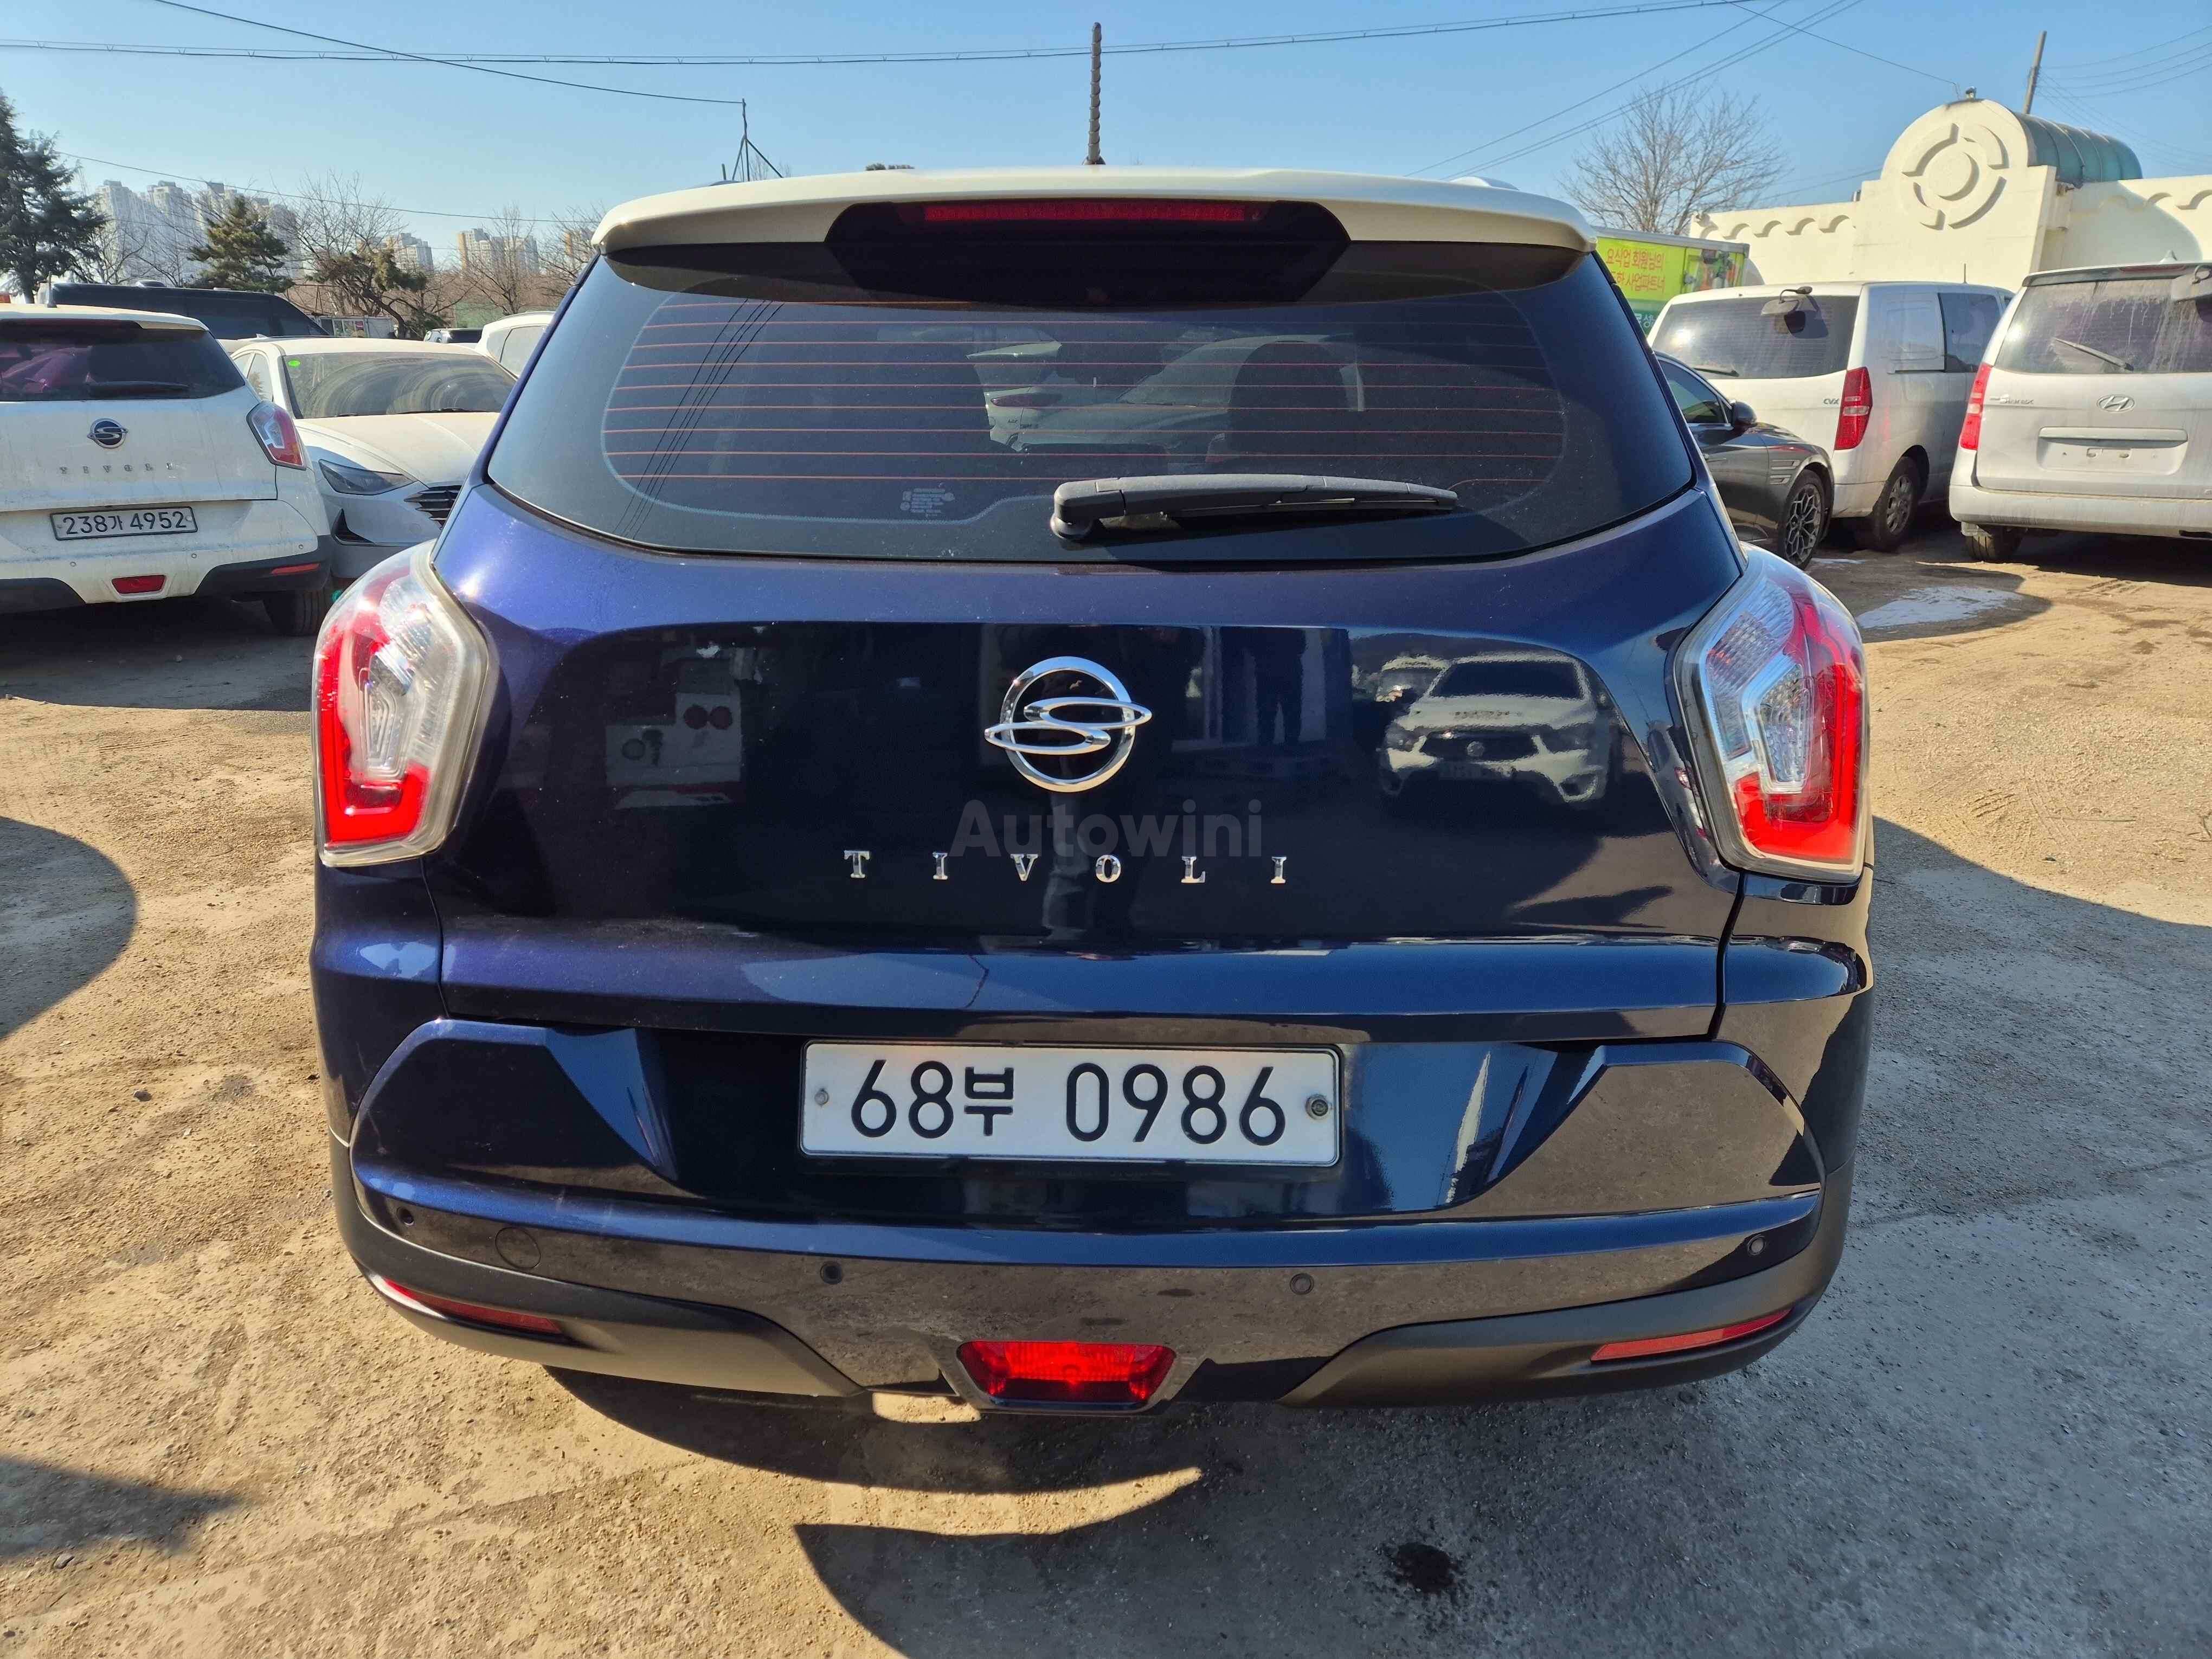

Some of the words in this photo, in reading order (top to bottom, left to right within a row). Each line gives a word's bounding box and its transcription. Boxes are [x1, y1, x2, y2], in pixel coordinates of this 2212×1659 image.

[62, 515, 123, 535] 238가
[130, 511, 187, 530] 4952
[843, 849, 1288, 884] TIVOLI
[850, 1059, 1014, 1139] 68부
[1065, 1062, 1287, 1146] 0986
